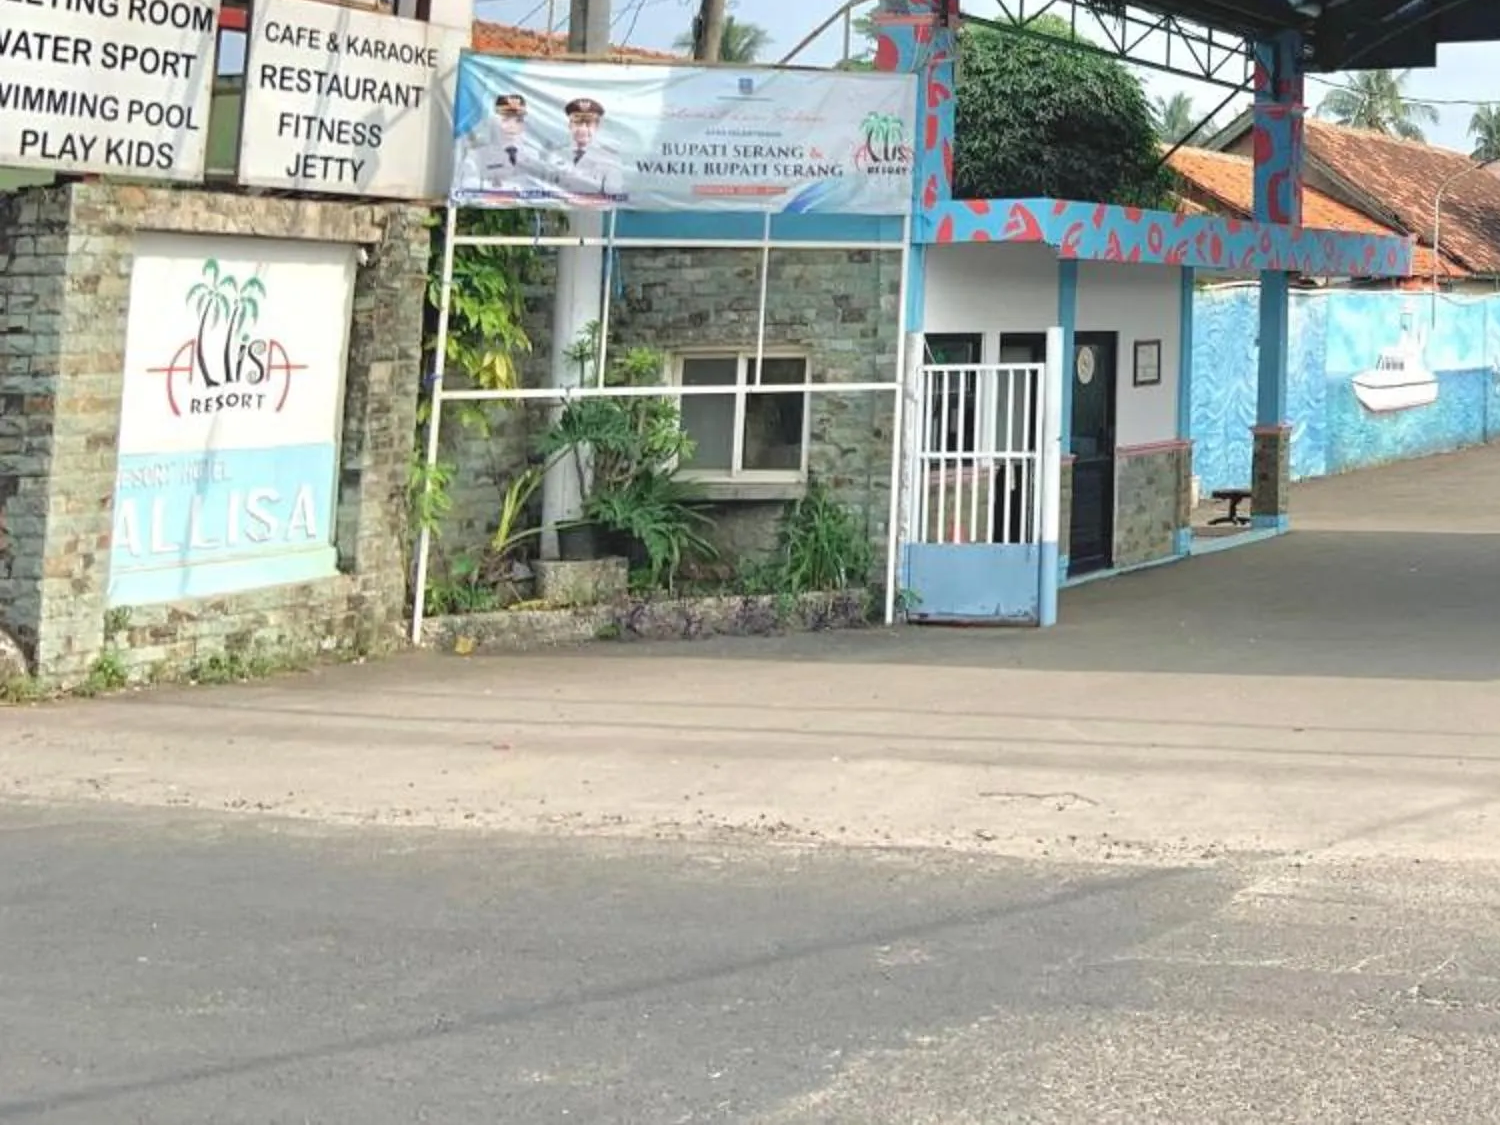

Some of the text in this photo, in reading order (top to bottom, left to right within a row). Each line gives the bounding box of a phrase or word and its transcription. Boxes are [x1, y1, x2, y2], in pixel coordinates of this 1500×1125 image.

[101, 41, 198, 79] SPORT
[265, 21, 439, 69] CAFE & KARAOKE
[259, 64, 425, 109] RESTAURANT
[0, 81, 200, 131] IMMING POOL
[277, 111, 384, 148] FITNESS
[19, 129, 175, 170] PLAY KIDS
[661, 142, 728, 157] BUPATI
[732, 144, 805, 159] SERANG
[285, 153, 367, 185] JETTY
[635, 160, 844, 178] WAKIL BUPATI SERANG
[189, 392, 267, 416] RESORT
[112, 482, 317, 559] ALLISA
